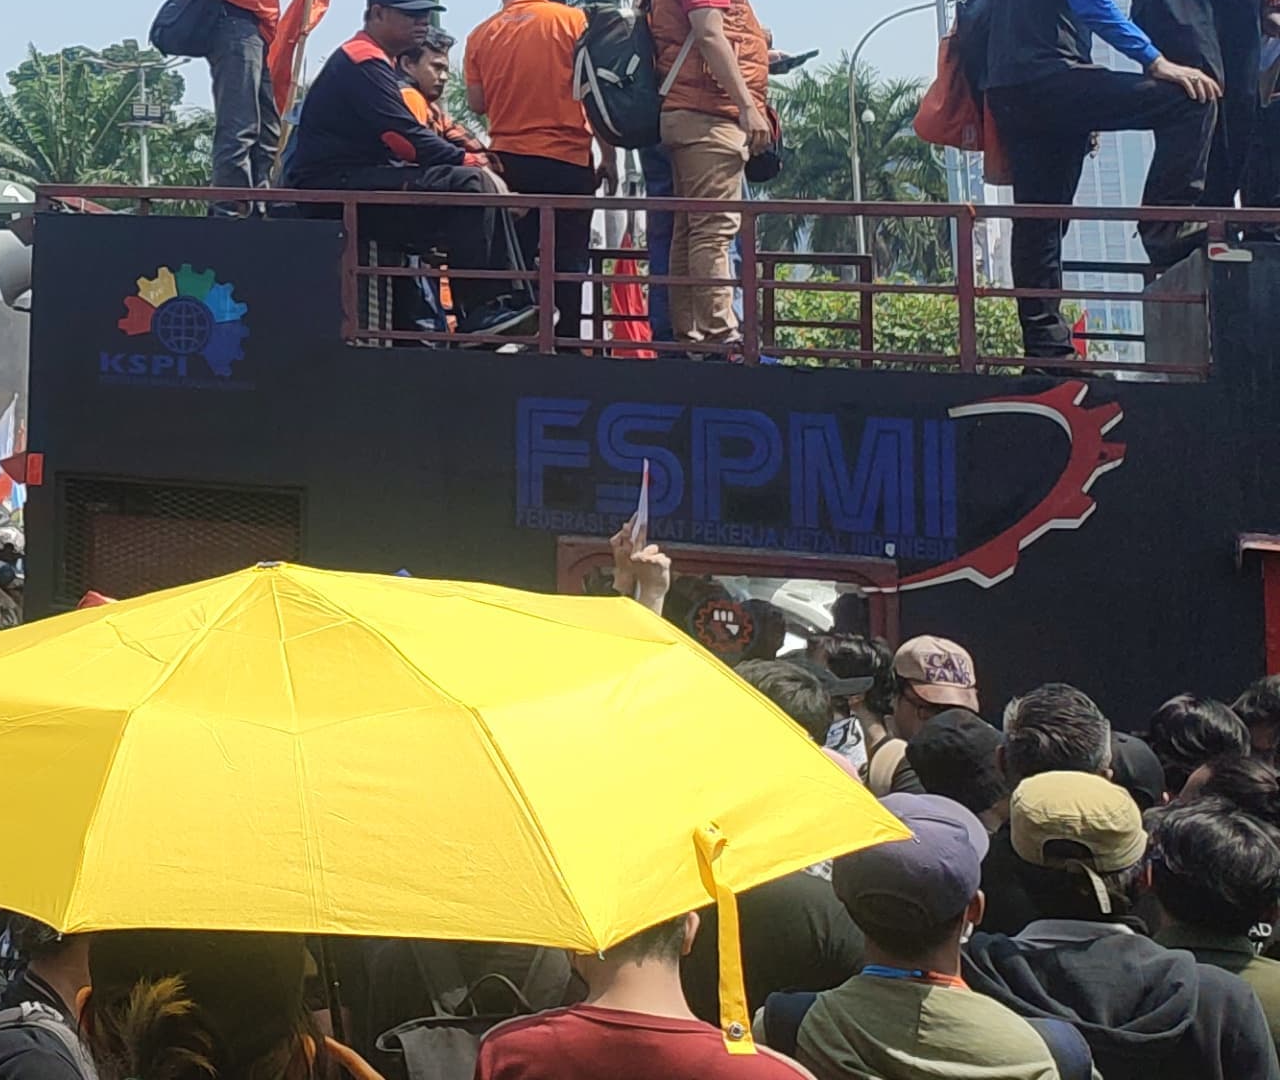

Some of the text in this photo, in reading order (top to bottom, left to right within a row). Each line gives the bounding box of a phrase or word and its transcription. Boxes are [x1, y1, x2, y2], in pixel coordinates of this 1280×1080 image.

[99, 351, 188, 377] KSPI
[516, 396, 958, 538] FSPMI
[516, 508, 603, 533] FEDERASI
[608, 515, 688, 540] SKAT
[692, 521, 778, 548] PEKERJA
[852, 533, 958, 560] INDNESIA
